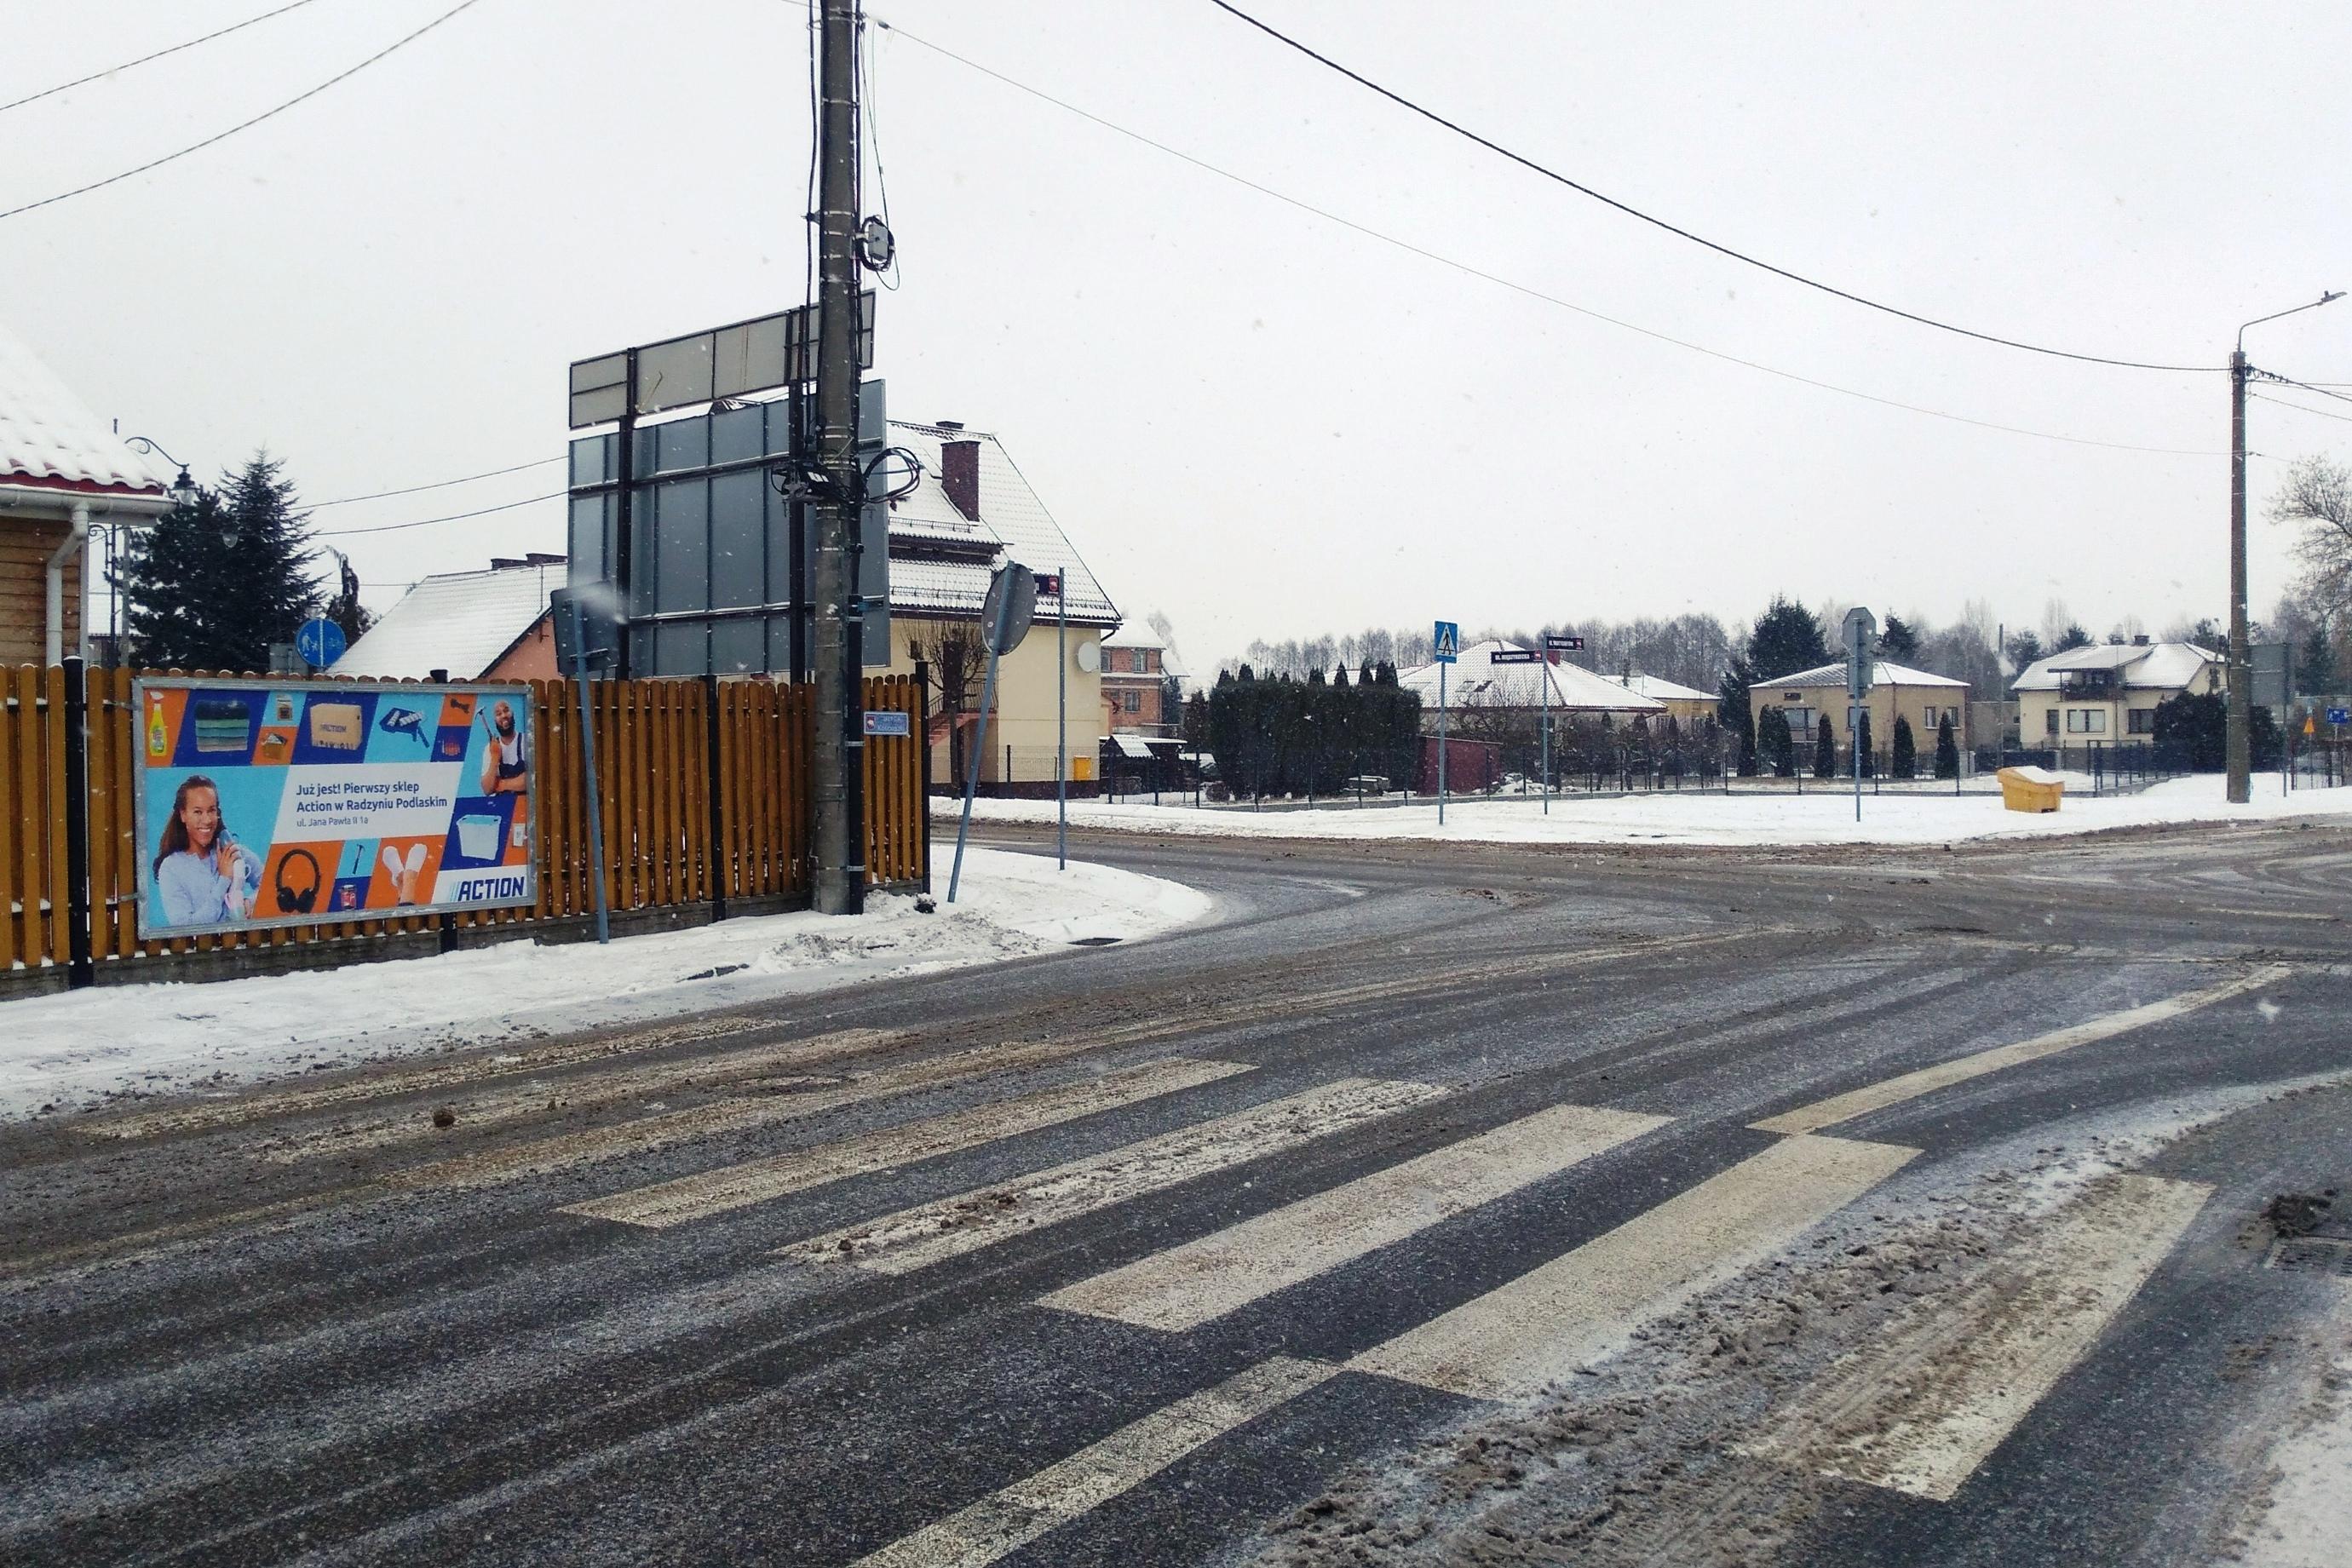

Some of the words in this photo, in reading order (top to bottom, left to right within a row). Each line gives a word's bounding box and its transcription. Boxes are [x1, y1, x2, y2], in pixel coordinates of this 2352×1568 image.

[296, 784, 314, 795] Już
[316, 783, 341, 797] jest!
[344, 783, 390, 795] Pierwszy
[393, 781, 419, 794] sklep
[296, 801, 332, 813] Action
[334, 802, 344, 811] w
[347, 798, 394, 812] Radzyniu
[396, 796, 447, 808] Podlaskim
[296, 819, 307, 828] ul.
[308, 818, 326, 827] Jana
[328, 816, 352, 826] Pawła
[359, 816, 369, 824] 1a
[457, 876, 525, 902] ACTION
